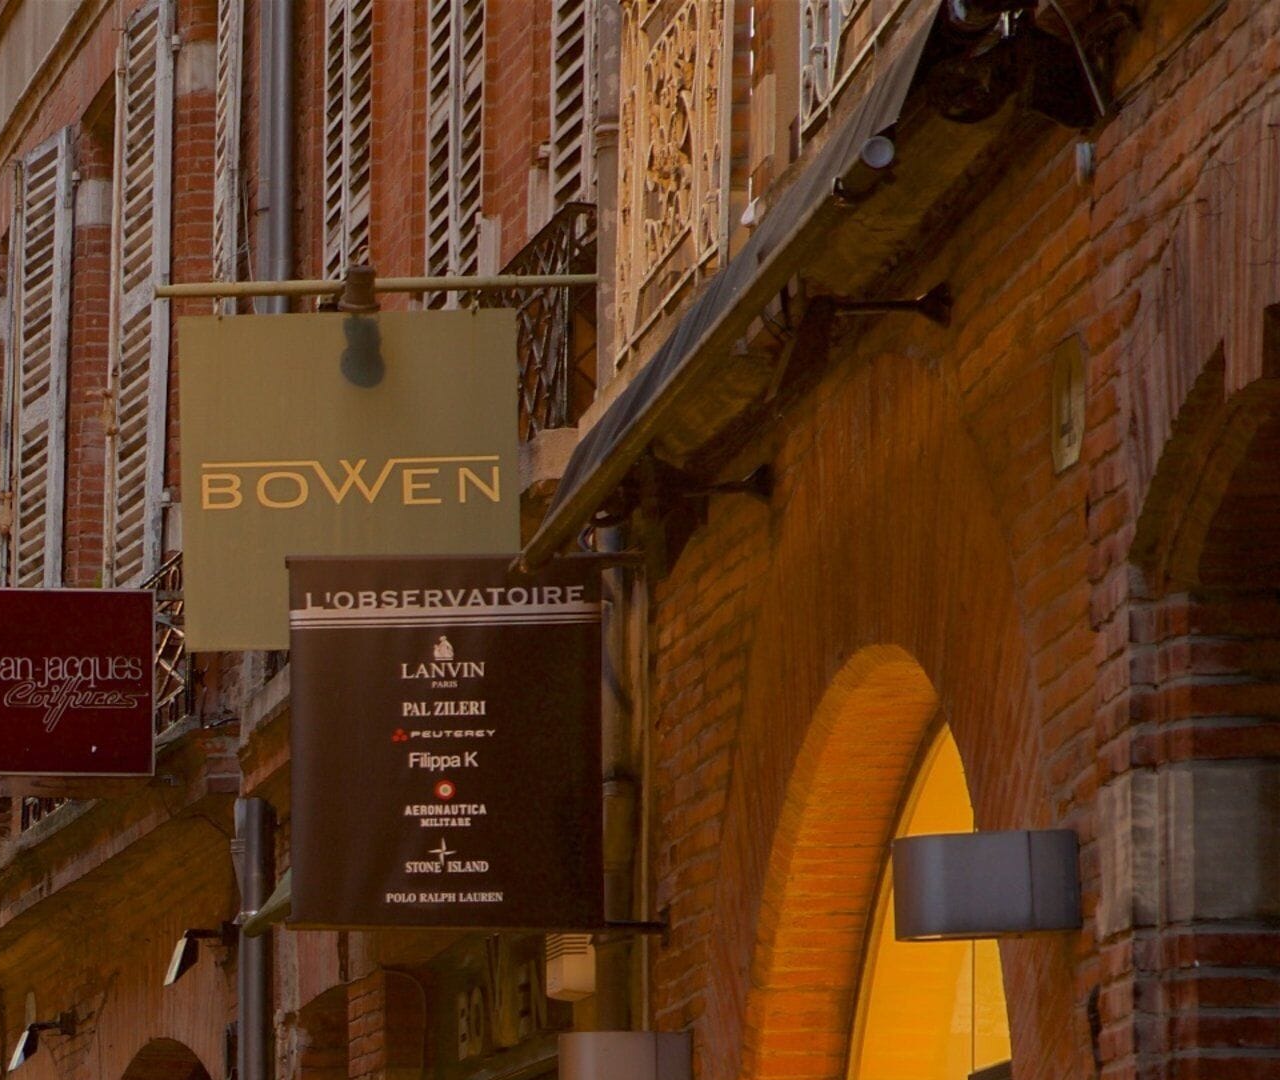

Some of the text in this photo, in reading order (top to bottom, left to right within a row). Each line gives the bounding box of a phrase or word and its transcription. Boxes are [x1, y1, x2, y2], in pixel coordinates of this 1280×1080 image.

[200, 455, 500, 511] BOWEN
[305, 585, 585, 610] L'OBSERVATOIRE
[401, 661, 485, 680] LANVIN
[432, 680, 458, 689] PARIS
[402, 700, 487, 717] PAL ZILERI
[408, 751, 479, 772] Filippa K
[404, 804, 488, 816] AERONAUTICA
[405, 859, 489, 874] STONE ISLAND
[386, 891, 504, 904] POLO RALPH LAUREN
